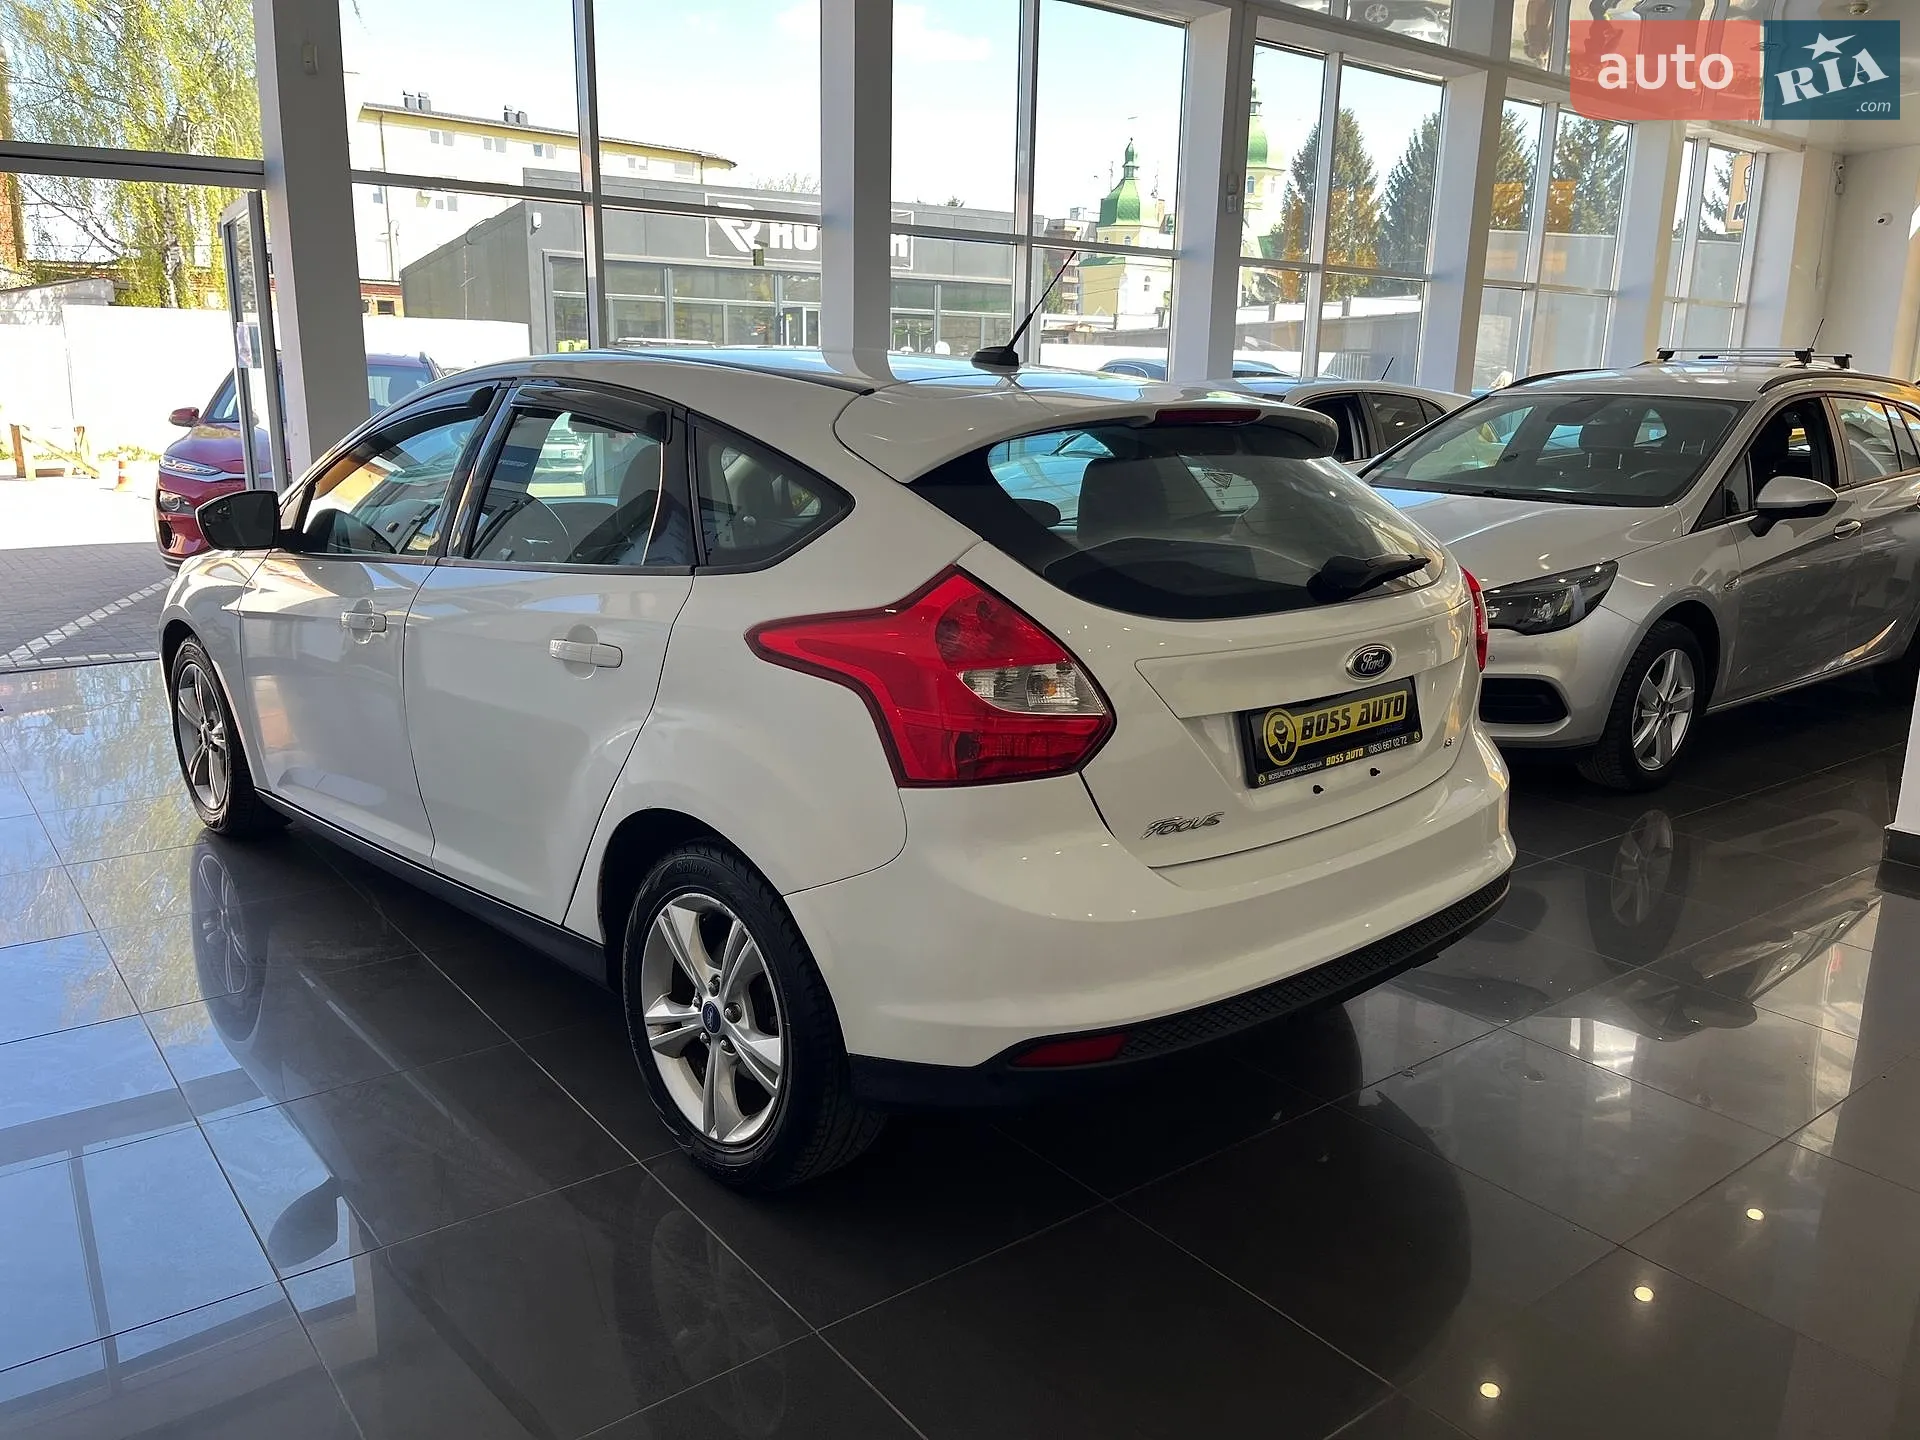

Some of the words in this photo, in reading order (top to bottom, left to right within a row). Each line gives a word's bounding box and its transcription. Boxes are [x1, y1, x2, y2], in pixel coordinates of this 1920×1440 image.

[1361, 652, 1385, 672] Ford
[1300, 707, 1352, 741] BOSS
[1357, 695, 1404, 727] AUTO
[1326, 752, 1344, 766] BOSS
[1346, 748, 1364, 760] AUTO
[1393, 737, 1400, 747] 02
[1400, 735, 1408, 745] 72
